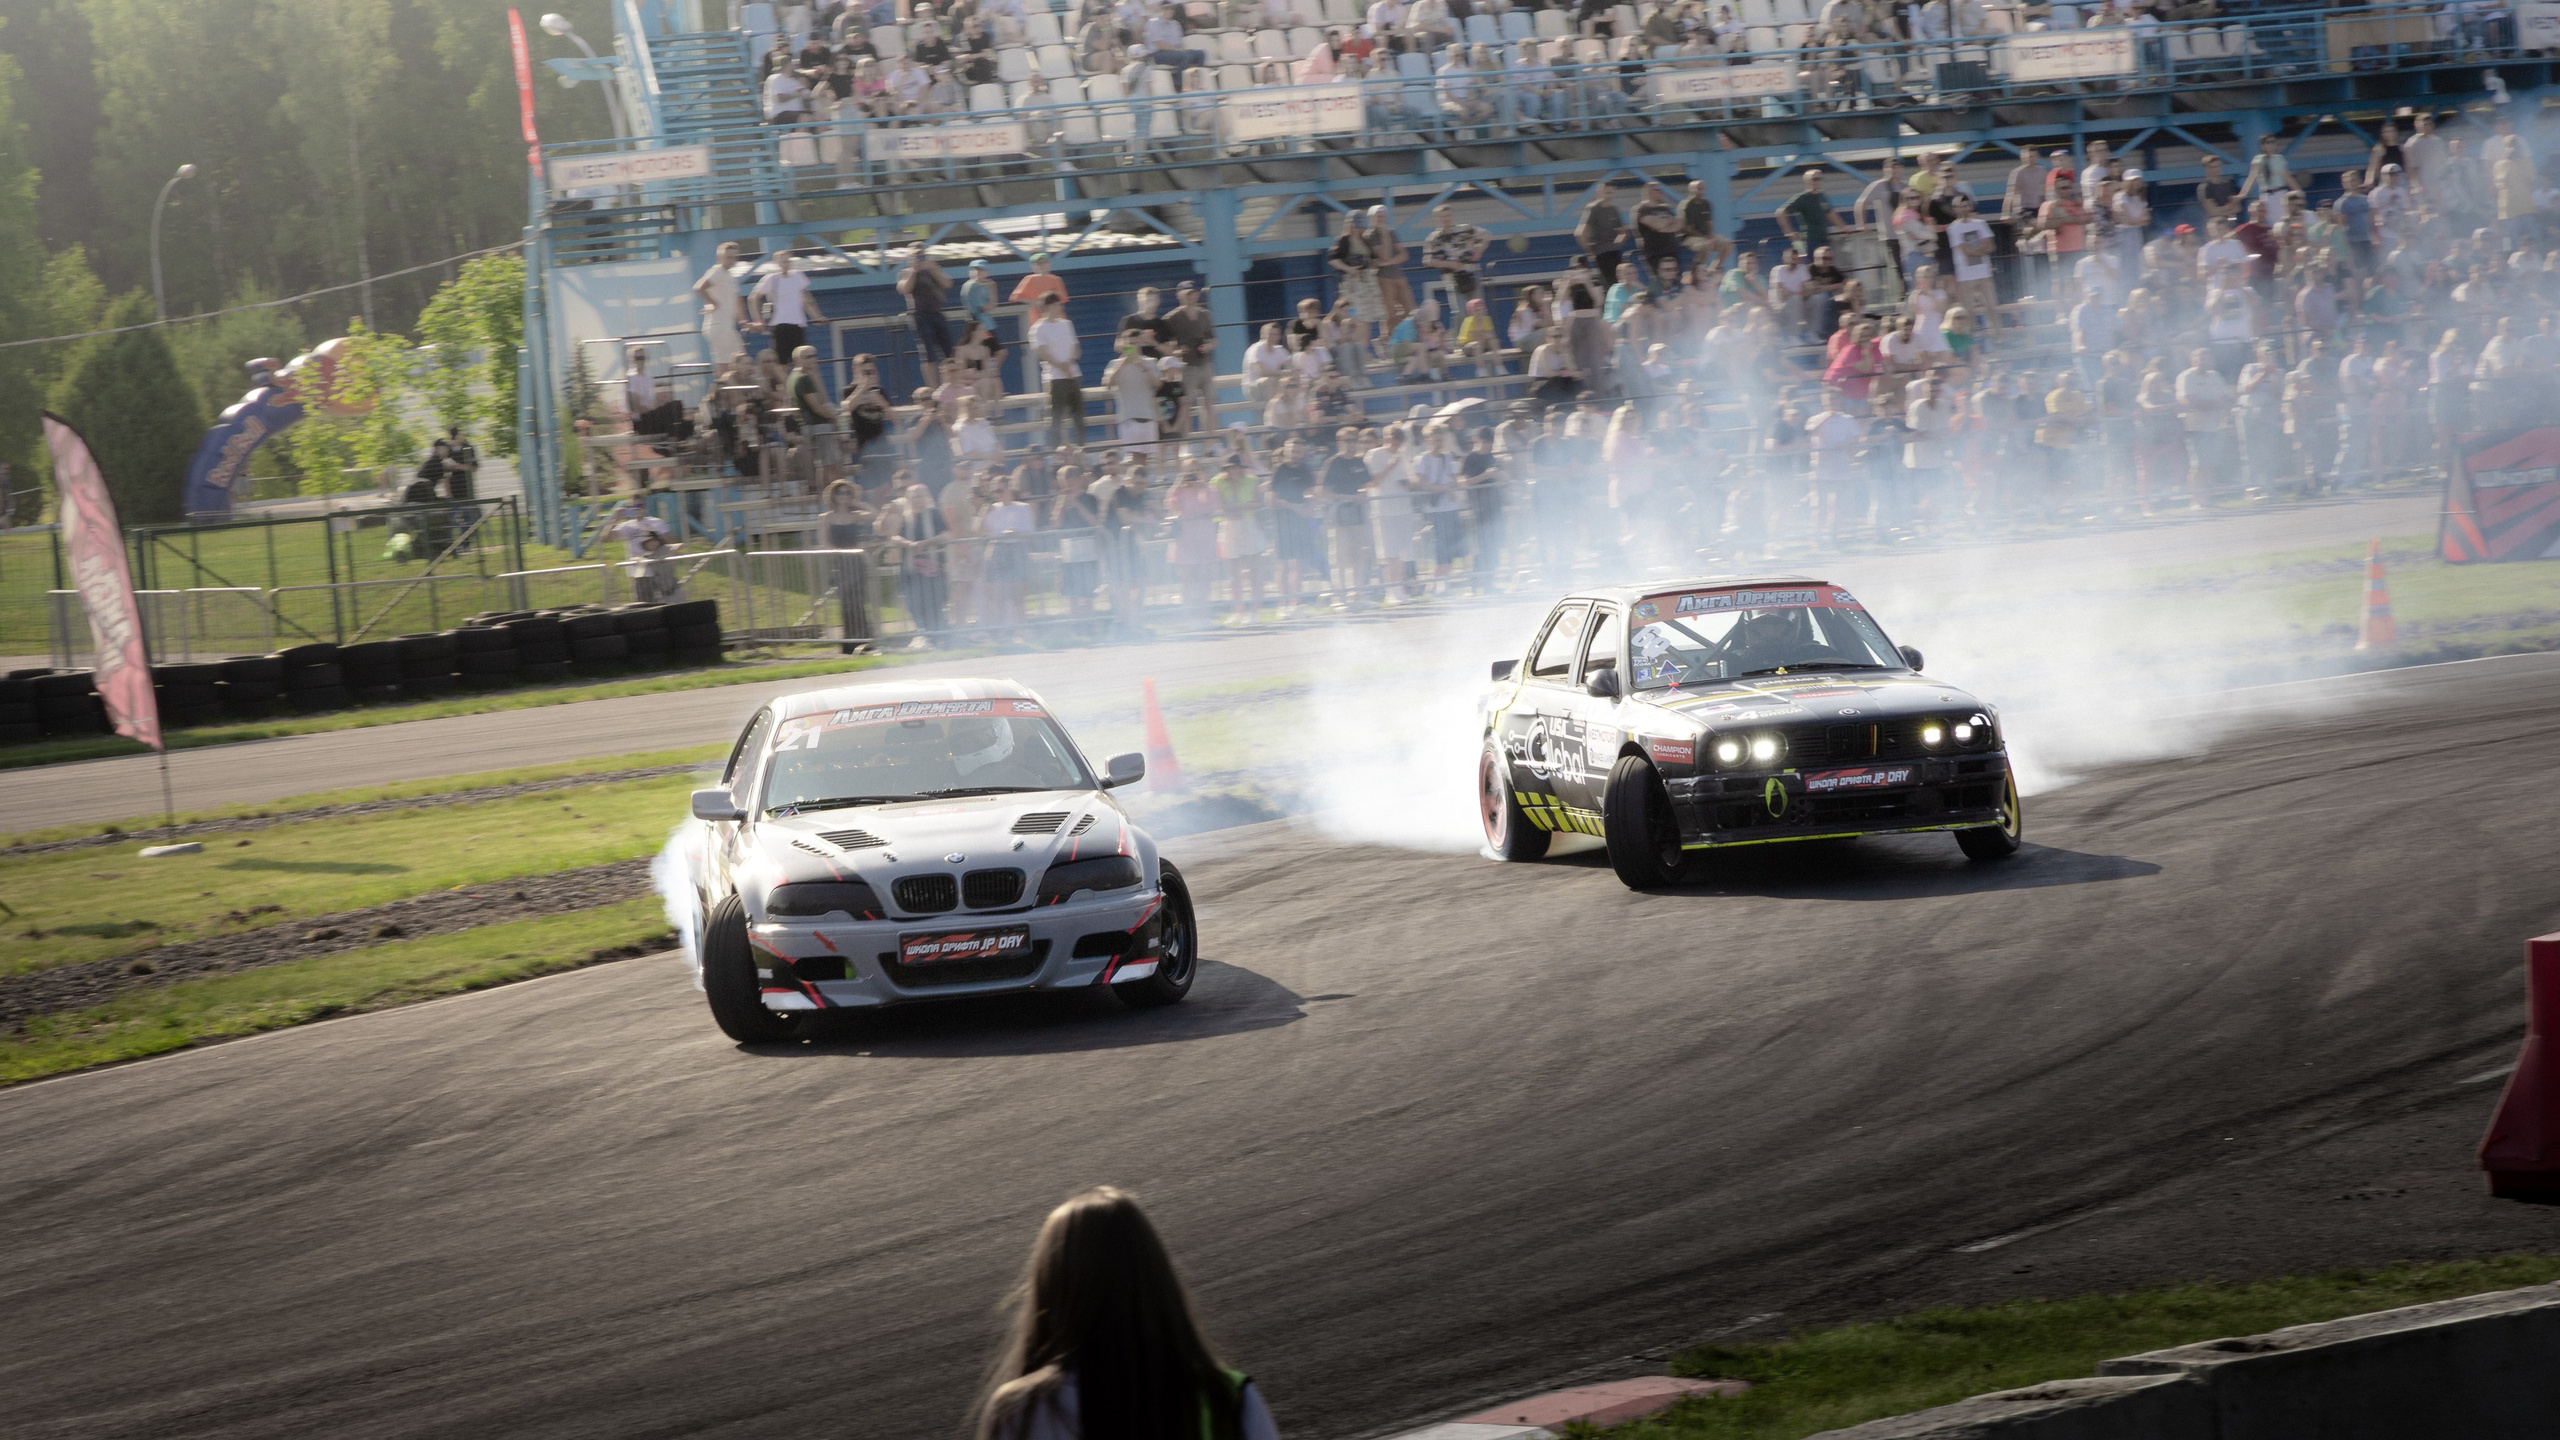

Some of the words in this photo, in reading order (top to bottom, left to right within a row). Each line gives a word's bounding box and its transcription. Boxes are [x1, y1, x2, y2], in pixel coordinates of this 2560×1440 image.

[774, 725, 822, 752] 21
[1653, 744, 1692, 754] CHAMPION
[1872, 772, 1885, 784] JP
[1887, 769, 1909, 783] DAY
[981, 936, 996, 951] JP
[997, 934, 1025, 950] DAY
